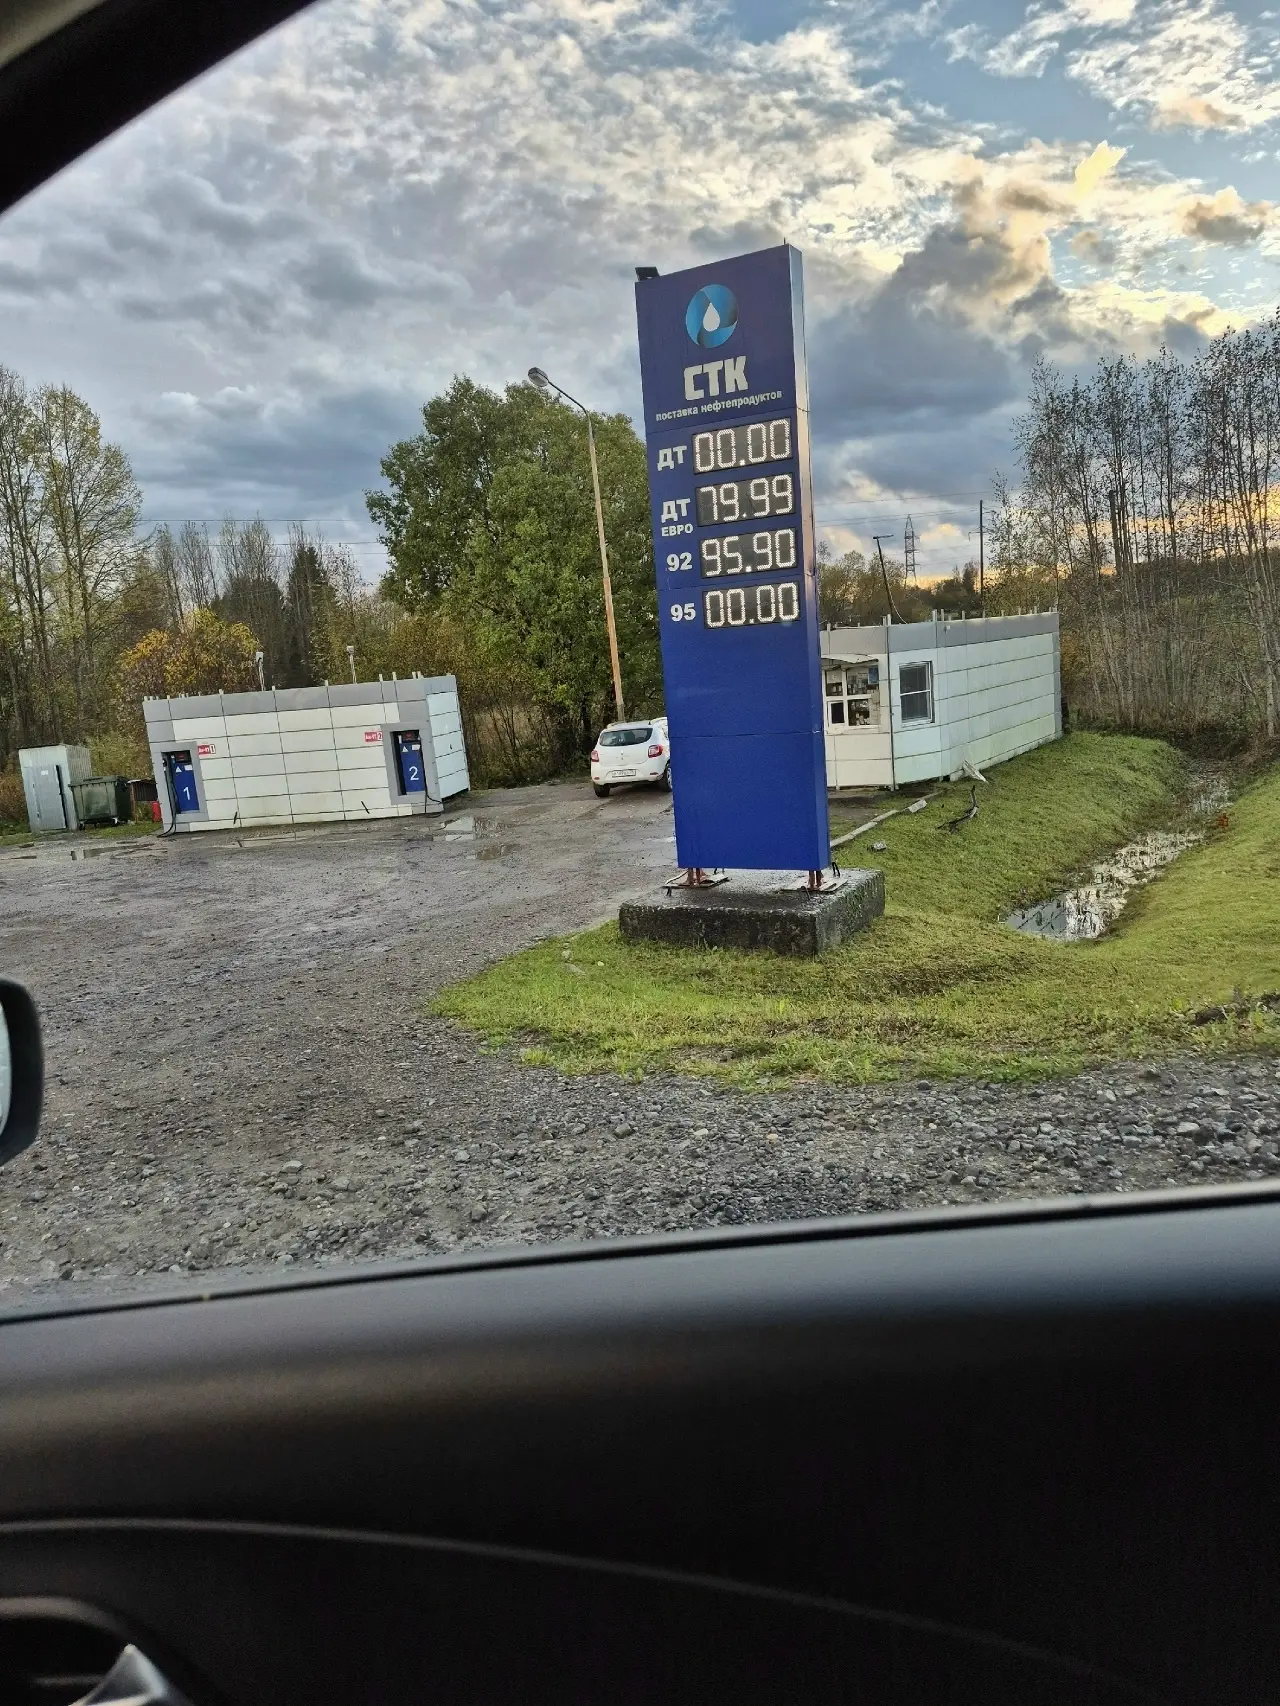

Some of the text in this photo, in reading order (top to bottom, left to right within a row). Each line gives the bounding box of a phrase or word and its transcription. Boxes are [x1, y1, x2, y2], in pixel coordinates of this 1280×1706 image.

[684, 356, 748, 400] СТК
[656, 391, 782, 421] поставка нефтепродуктов
[657, 418, 790, 472] ДТ 00.00
[661, 474, 792, 523] ДТ 79.99
[661, 523, 693, 537] ЕВРО
[666, 528, 795, 576] 92 95.90
[670, 582, 799, 627] 95 00.00
[183, 787, 190, 800] 1
[409, 766, 419, 780] 2
